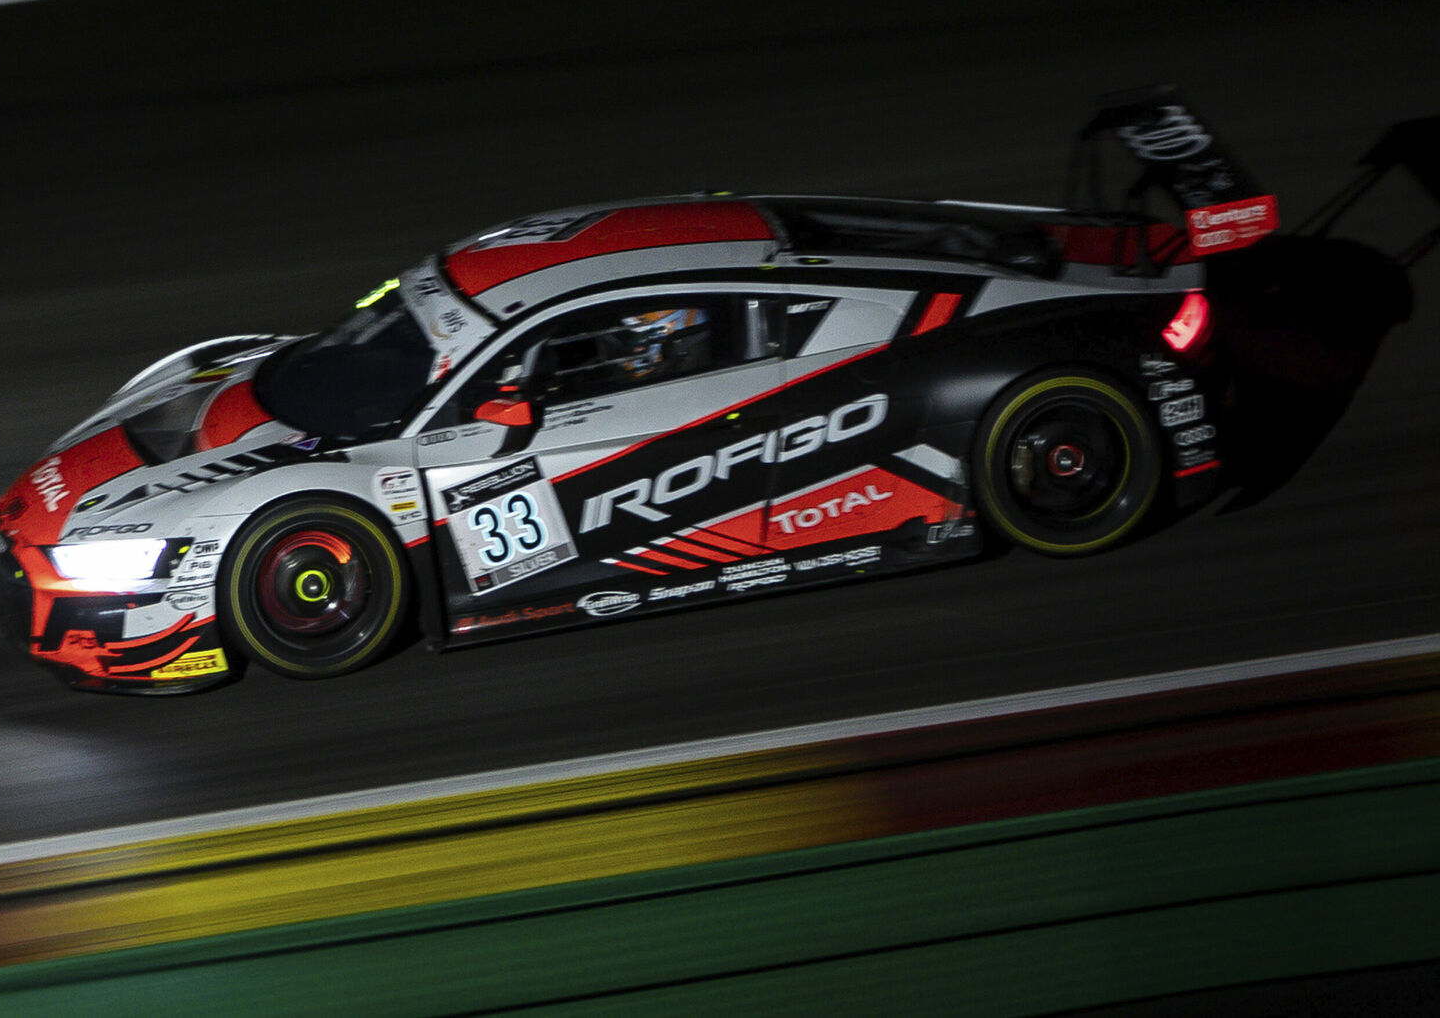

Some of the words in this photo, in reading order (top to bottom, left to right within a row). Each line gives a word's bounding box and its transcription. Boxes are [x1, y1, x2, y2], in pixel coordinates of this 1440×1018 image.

[578, 393, 889, 533] ROFGO
[470, 492, 548, 566] 33
[768, 485, 894, 534] TOTAL
[523, 602, 576, 621] Sport
